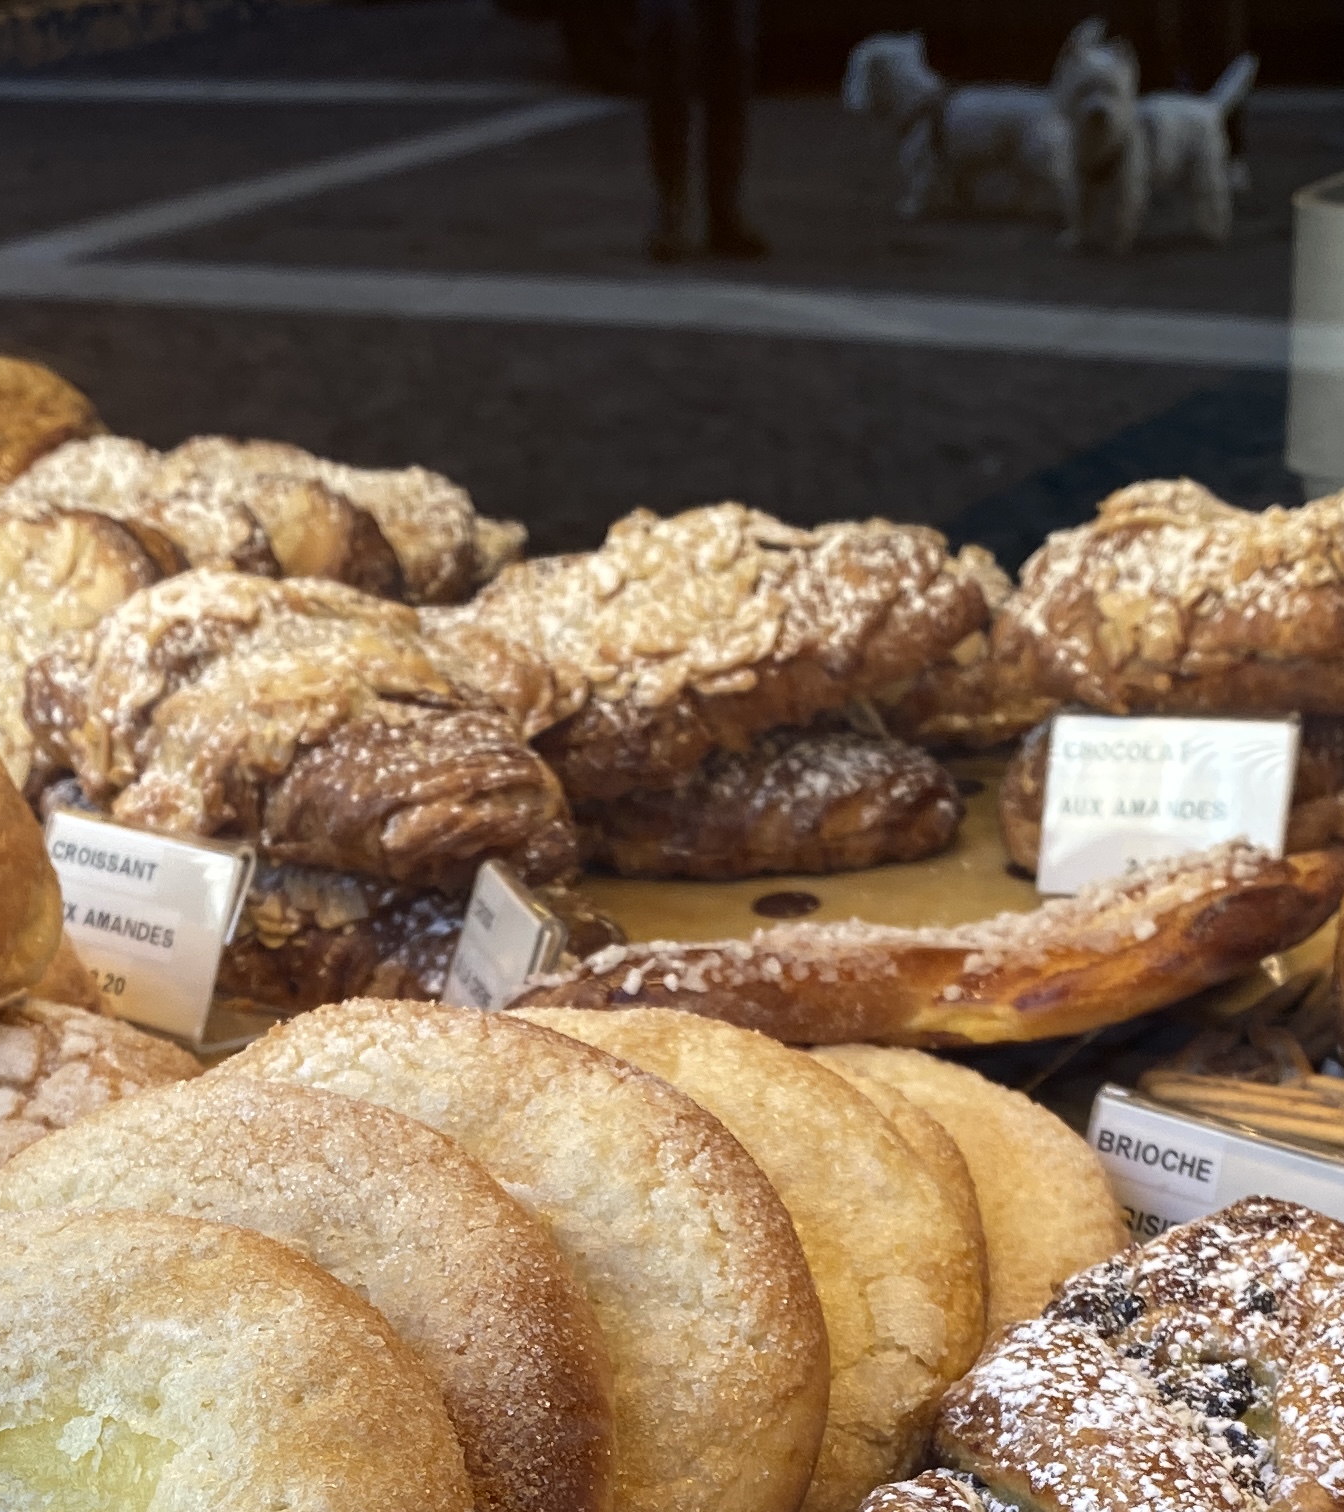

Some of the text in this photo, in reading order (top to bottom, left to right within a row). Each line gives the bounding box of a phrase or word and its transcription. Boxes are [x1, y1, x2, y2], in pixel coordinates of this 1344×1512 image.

[51, 840, 158, 882] CROISSANT
[83, 908, 175, 949] AMANDES
[1097, 1129, 1213, 1183] BRIOCHE
